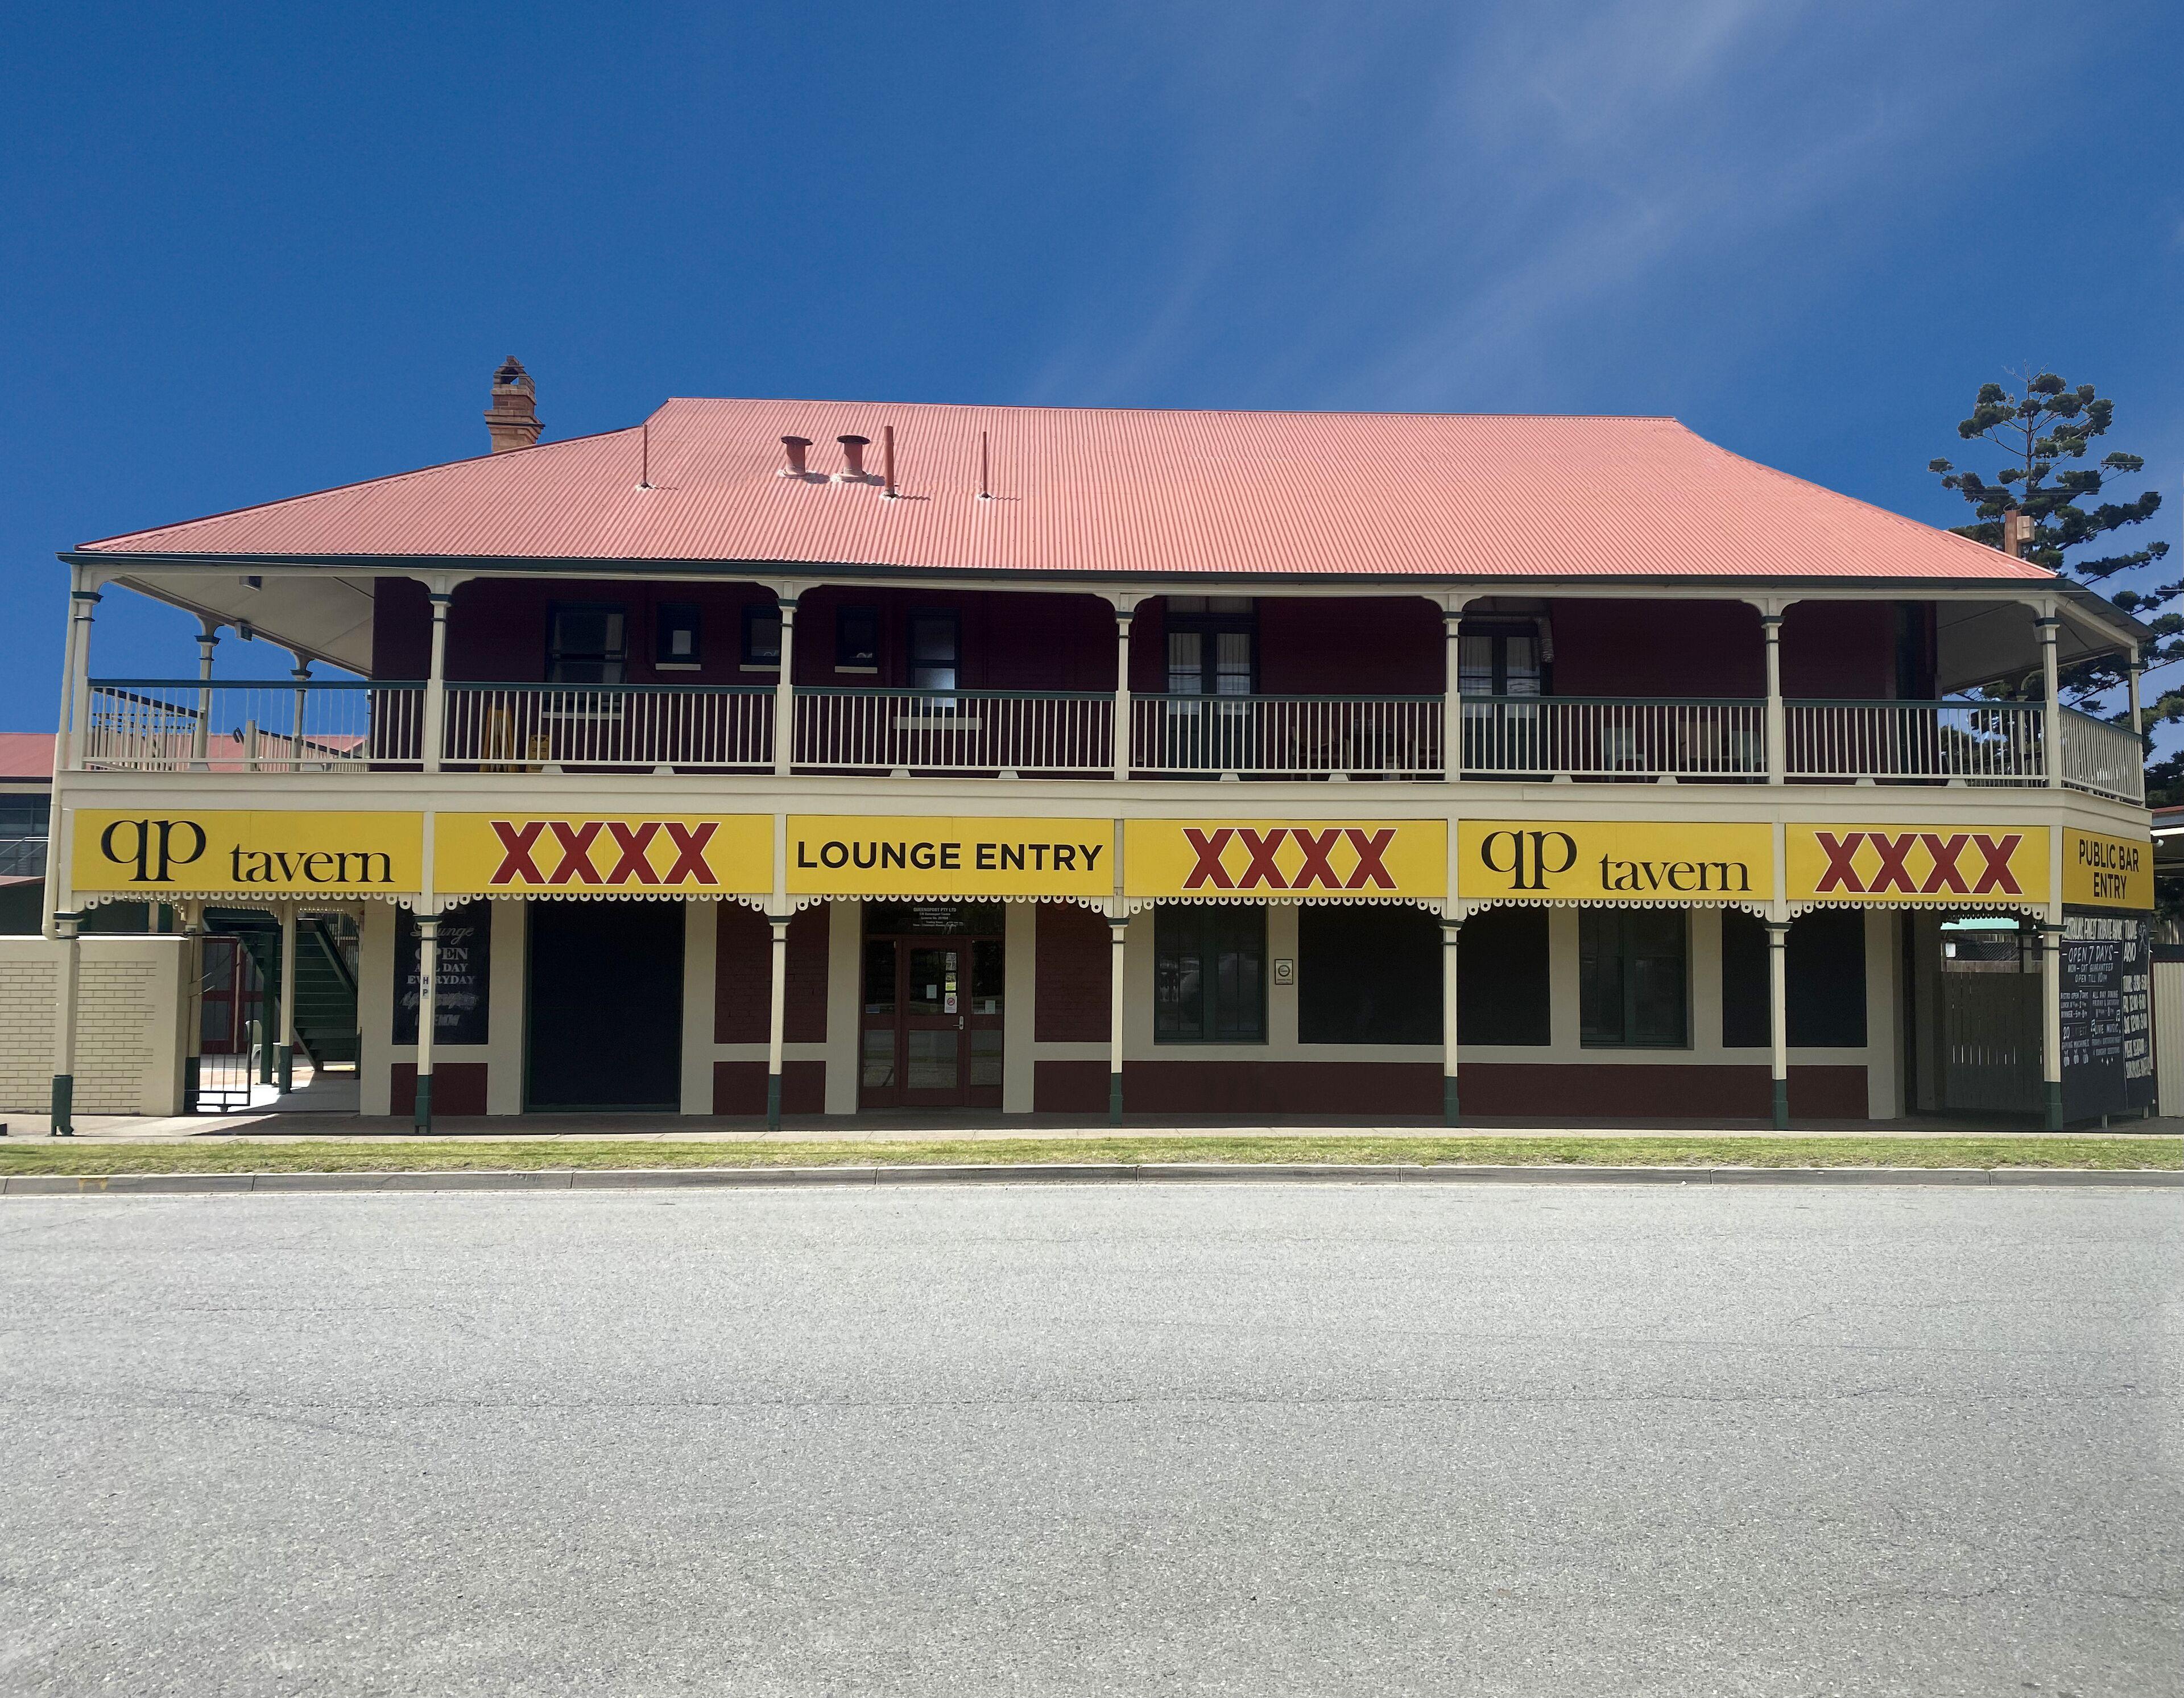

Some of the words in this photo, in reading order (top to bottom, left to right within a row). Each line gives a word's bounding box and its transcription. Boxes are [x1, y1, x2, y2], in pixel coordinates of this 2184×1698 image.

[100, 819, 206, 881] qp
[229, 844, 396, 883] tavern
[488, 821, 721, 886] XXXX
[797, 841, 962, 870] LOUNGE
[975, 842, 1104, 871] ENTRY
[1181, 828, 1399, 890] XXXX
[1481, 829, 1578, 890] qp
[1598, 853, 1753, 891] tavern
[1813, 832, 2025, 895] XXXX
[2079, 838, 2116, 869] PUBLIC
[2119, 846, 2139, 872] BAR
[2094, 871, 2127, 899] ENTRY
[442, 962, 468, 973] DAY
[2069, 946, 2087, 963] OPEN
[2088, 945, 2094, 964] 7
[2095, 944, 2113, 962] DAYS
[406, 975, 475, 985] EVRYDAY
[2075, 974, 2087, 983] OPEN
[2088, 974, 2096, 983] TILL
[2063, 1026, 2070, 1040] 20
